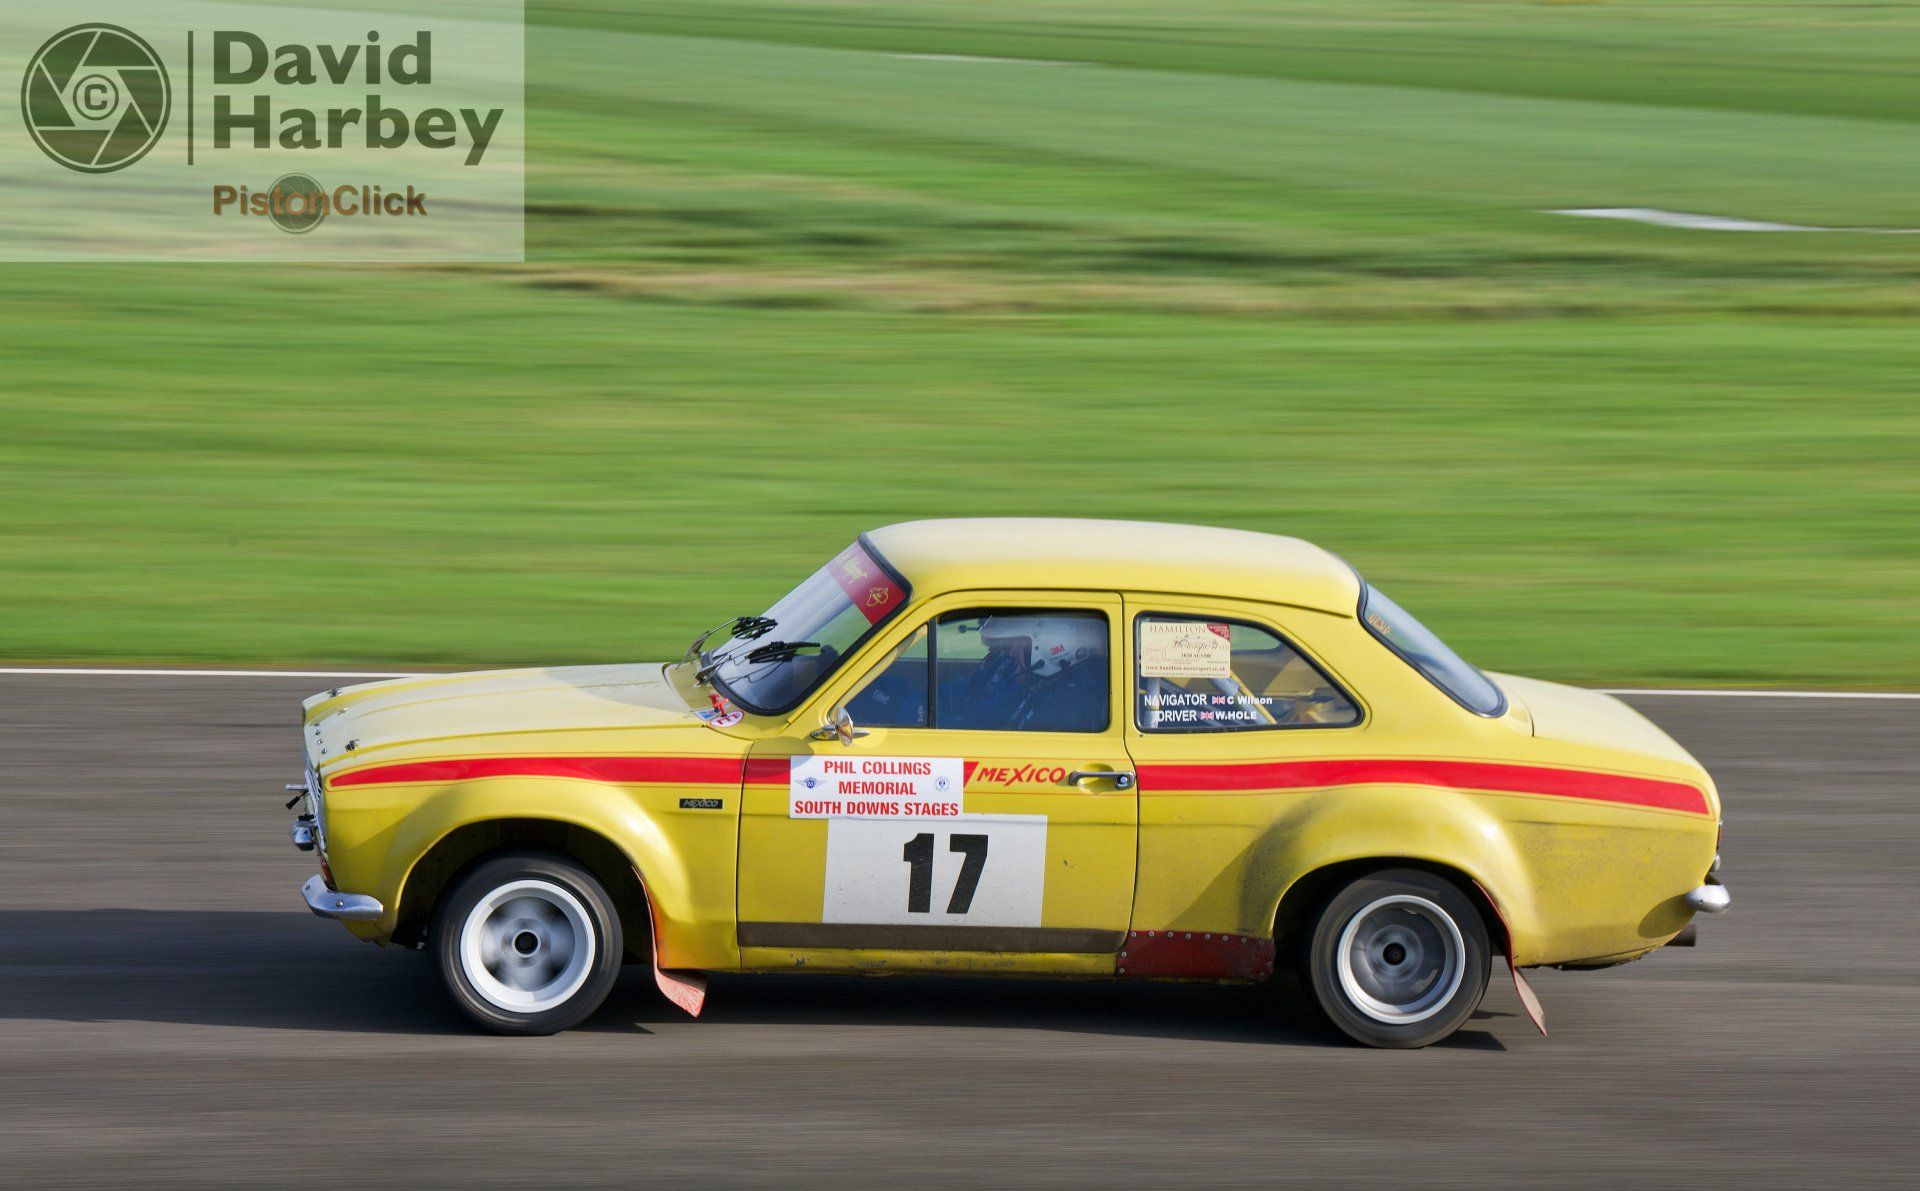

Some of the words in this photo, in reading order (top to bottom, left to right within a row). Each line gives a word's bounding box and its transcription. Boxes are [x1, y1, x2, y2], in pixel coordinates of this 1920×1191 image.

[1149, 624, 1206, 633] HAMILTON
[1144, 694, 1207, 706] NAVIGATOR
[1227, 696, 1234, 705] C
[1238, 695, 1272, 705] Wilson
[1158, 710, 1197, 722] DRIVER
[1215, 711, 1257, 720] W.HOLE
[824, 761, 856, 774] PHIL
[862, 761, 931, 775] COLLINGS
[976, 763, 1066, 787] MEXICO
[838, 781, 916, 795] MEMORIAL
[795, 801, 841, 814] SOUTH
[847, 802, 899, 815] DOWNS
[904, 803, 959, 816] STAGES
[903, 833, 988, 914] 17
